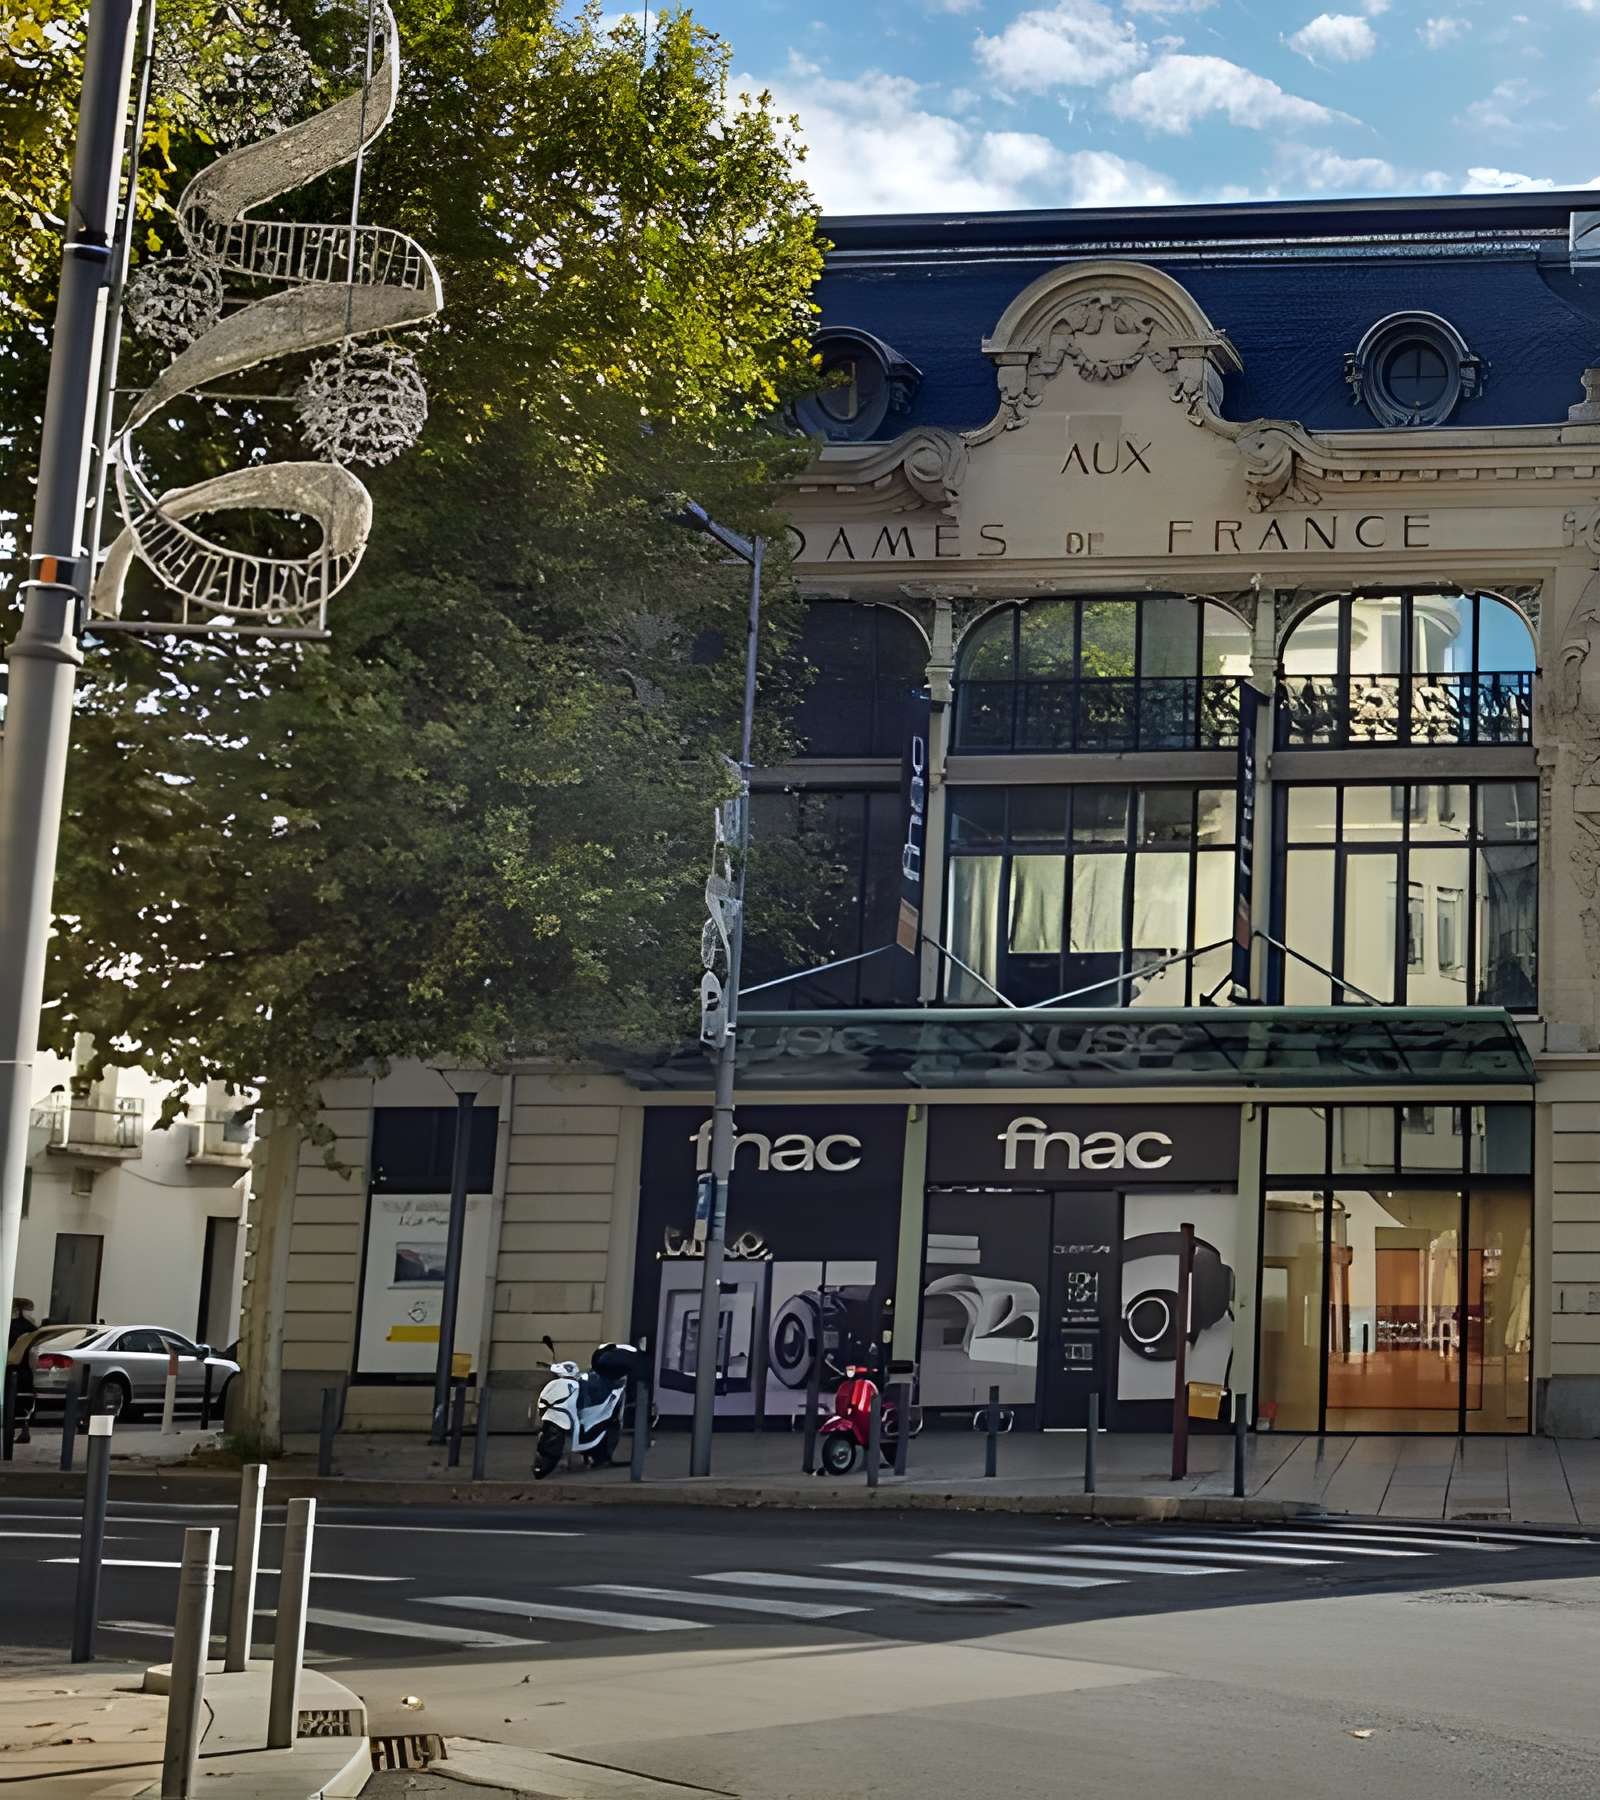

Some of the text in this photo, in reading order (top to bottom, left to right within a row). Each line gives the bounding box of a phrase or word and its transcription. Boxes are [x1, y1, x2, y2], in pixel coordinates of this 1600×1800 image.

[1061, 440, 1152, 475] AUX
[1065, 531, 1105, 556] DE
[1168, 513, 1430, 554] FRANCE
[688, 1118, 862, 1172] fnac
[997, 1116, 1174, 1170] fnac
